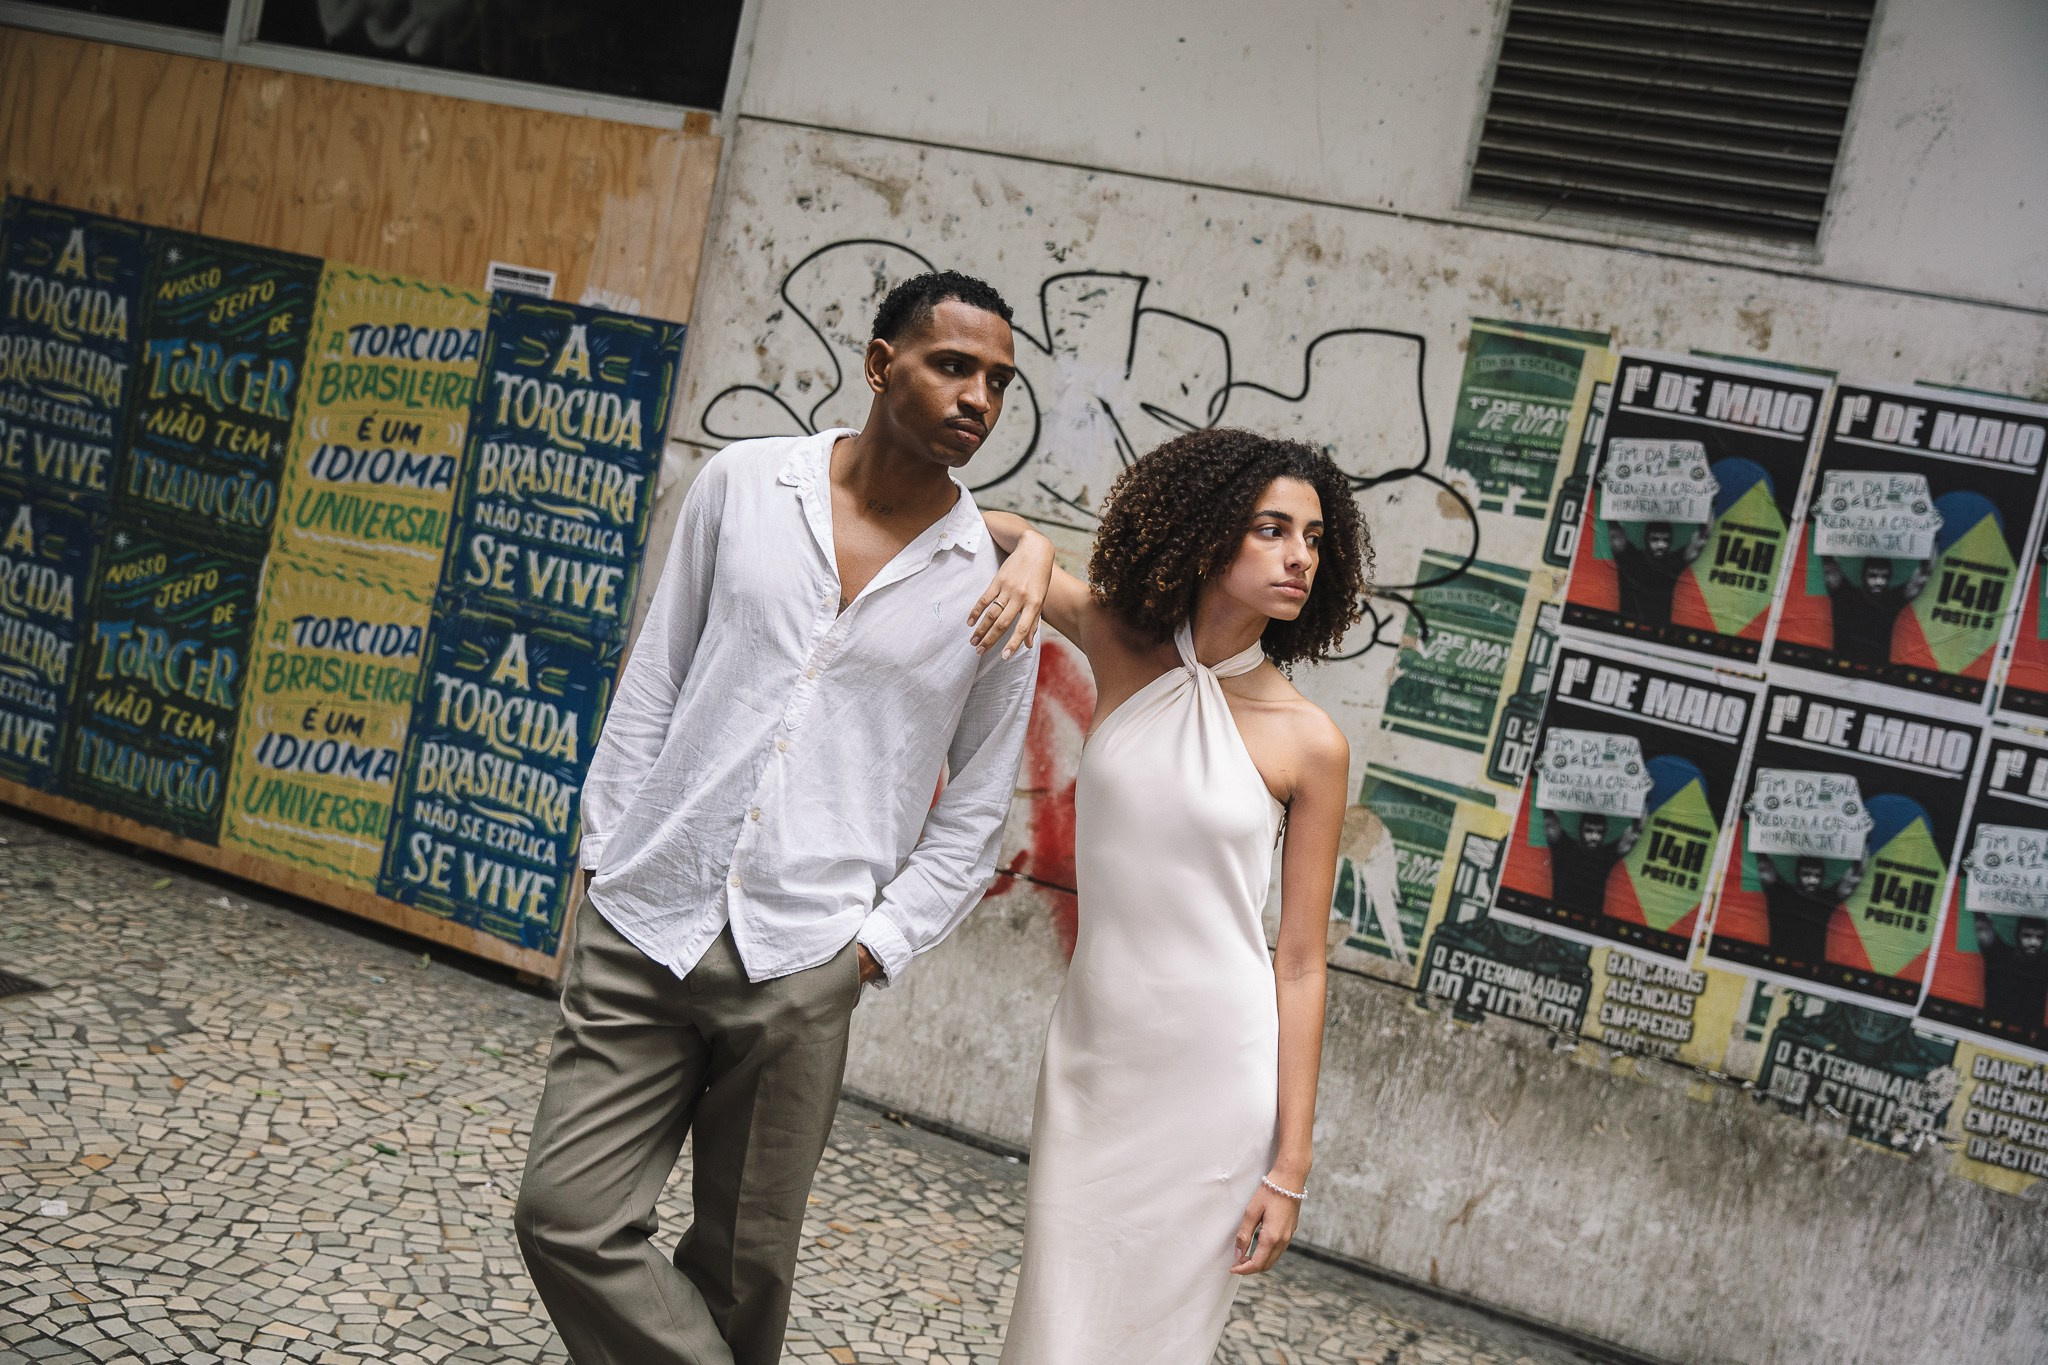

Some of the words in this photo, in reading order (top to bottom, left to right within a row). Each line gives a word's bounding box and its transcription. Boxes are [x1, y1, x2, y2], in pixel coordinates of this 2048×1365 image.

[55, 228, 87, 280] A
[7, 268, 128, 343] TORCIDA
[158, 267, 222, 300] NOSSO
[208, 279, 276, 323] JEITO
[267, 312, 294, 336] DE
[327, 331, 344, 353] A
[348, 323, 483, 362] TORCIDA
[553, 323, 593, 382] A
[316, 361, 476, 411] BRASILEIRA
[493, 369, 643, 453] TORCIDA
[1492, 399, 1523, 417] DE
[1653, 371, 1704, 416] DE
[1705, 379, 1814, 434] MAIO
[29, 397, 50, 423] SE
[51, 402, 113, 438] EXPLICA
[147, 402, 207, 444] NÃO
[214, 420, 272, 460] TEM
[357, 410, 378, 441] É
[381, 417, 423, 447] UM
[1871, 400, 1928, 447] DE
[1928, 408, 2047, 467] MAIO
[33, 432, 112, 492] VIVE
[309, 443, 458, 491] IDIOMA
[476, 440, 646, 526] BRASILEIRA
[128, 448, 276, 528] TRADUÇÃO
[4, 503, 35, 558] A
[295, 487, 448, 550] UNIVERSAL
[475, 500, 522, 534] NÃO
[521, 511, 547, 541] SE
[550, 516, 626, 558] EXPLICA
[106, 553, 168, 584] NOSSO
[464, 532, 520, 593] SE
[527, 549, 626, 618] VIVE
[1715, 534, 1777, 576] 14H
[154, 568, 219, 609] JEITO
[1708, 569, 1756, 590] POSTO
[1757, 577, 1769, 593] 5
[1937, 571, 2006, 613] 14H
[212, 602, 236, 625] DE
[272, 622, 290, 644] A
[293, 614, 424, 659] TORCIDA
[1931, 606, 1982, 629] POSTO
[1983, 616, 1995, 632] 5
[490, 632, 531, 692] A
[1437, 631, 1467, 649] DE
[262, 652, 417, 705] BRASILEIRA
[1590, 664, 1642, 711] DE
[1641, 677, 1747, 737] MAIO
[95, 687, 153, 727] NÃO
[161, 705, 216, 746] TEM
[302, 701, 323, 732] É
[324, 709, 366, 738] UM
[434, 670, 579, 764] TORCIDA
[1802, 700, 1857, 749] DE
[1858, 713, 1974, 773] MAIO
[76, 726, 221, 814] TRADUÇÃO
[257, 731, 400, 784] IDIOMA
[416, 740, 579, 836] BRASILEIRA
[413, 799, 459, 833] NÃO
[457, 814, 484, 842] SE
[485, 821, 559, 868] EXPLICA
[1647, 831, 1708, 874] 14H
[403, 829, 457, 892] SE
[462, 850, 556, 925] VIVE
[1641, 863, 1687, 887] POSTO
[1688, 876, 1700, 892] 5
[1870, 872, 1936, 916] 14H
[1864, 906, 1914, 930] POSTO
[1916, 918, 1928, 934] 5
[1432, 945, 1448, 968] O
[1449, 950, 1584, 1009] EXTERMINADOR
[1604, 977, 1695, 1017] AGÊNCIAS
[1600, 1001, 1695, 1041] EMPREGOS
[1774, 1039, 1793, 1065] O
